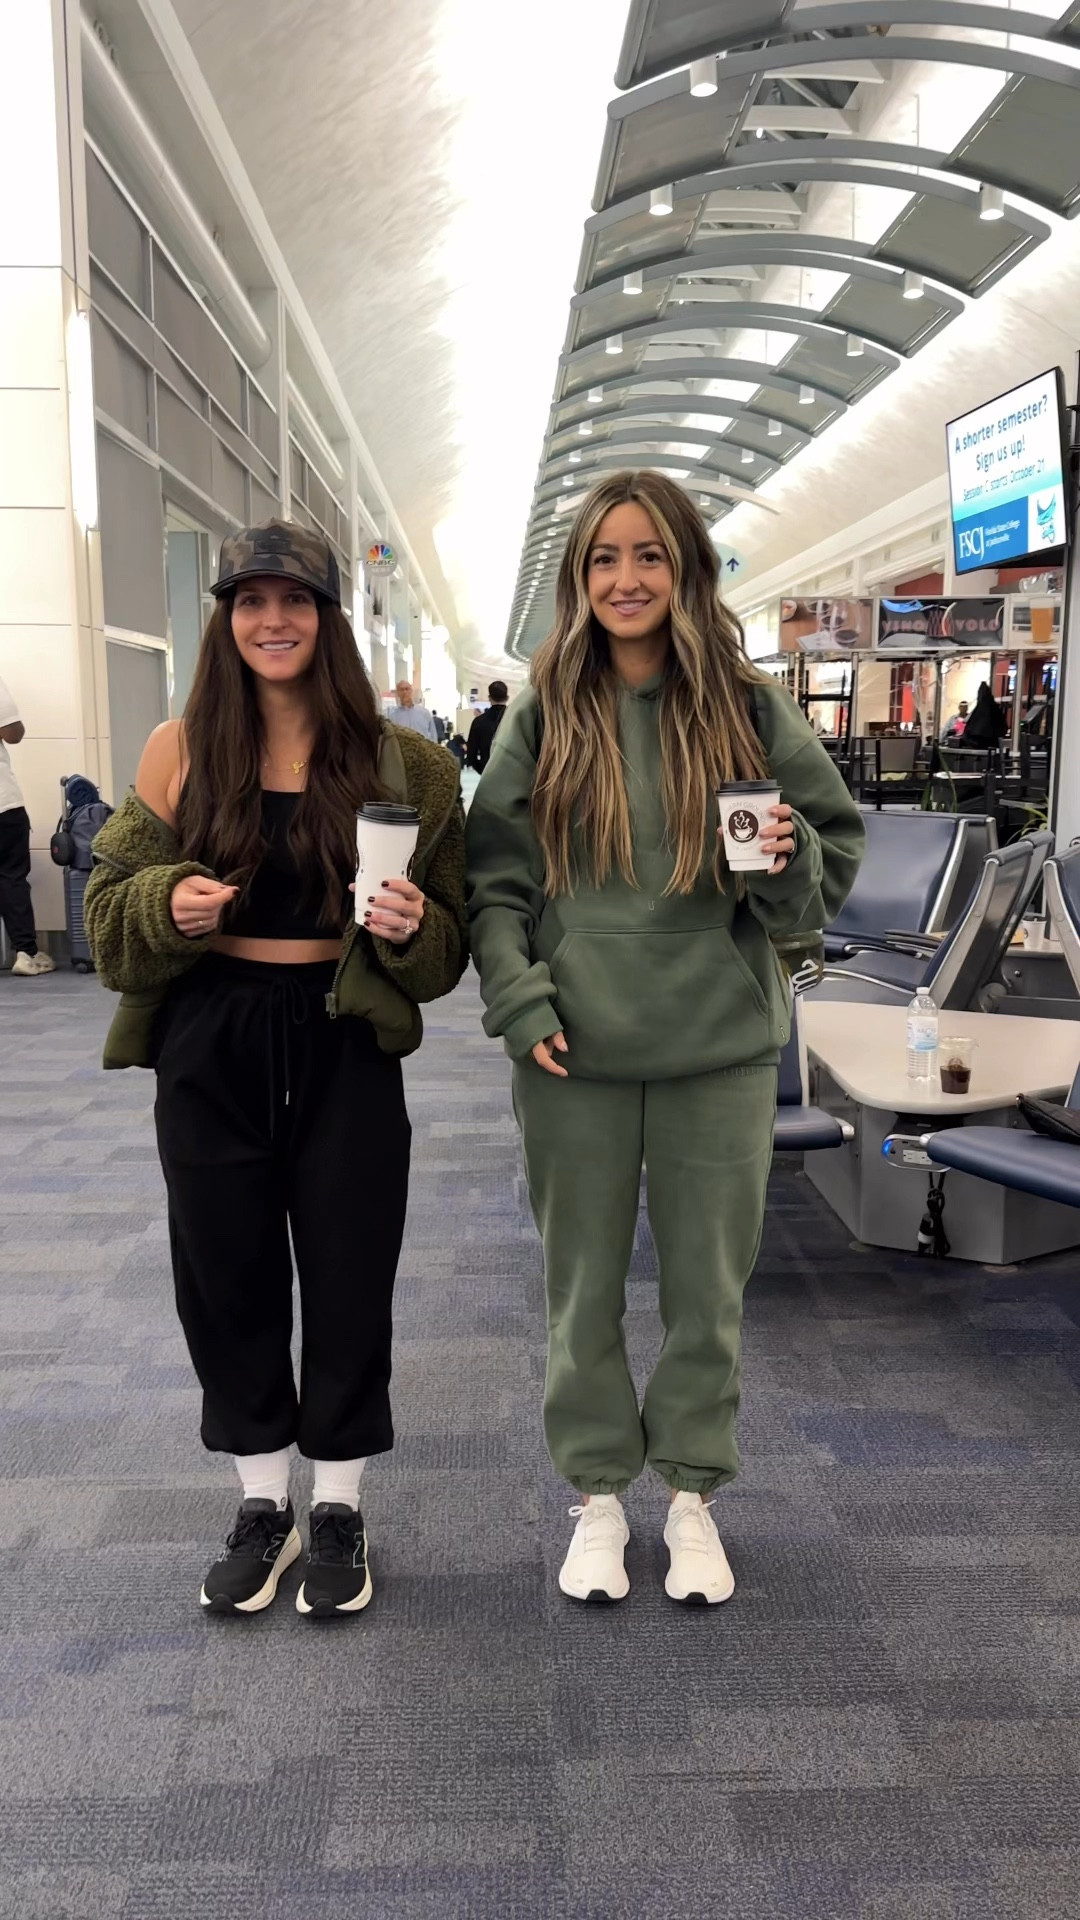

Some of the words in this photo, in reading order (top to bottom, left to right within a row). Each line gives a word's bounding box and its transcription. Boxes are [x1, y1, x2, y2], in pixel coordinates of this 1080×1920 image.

[955, 437, 961, 454] A
[962, 423, 995, 450] shorter
[997, 394, 1048, 434] semester?
[976, 451, 995, 472] Sign
[997, 444, 1008, 463] us
[1010, 434, 1026, 458] up!
[1010, 464, 1036, 483] October
[958, 526, 985, 561] FSCJ
[882, 619, 925, 633] VINO
[955, 618, 999, 632] VOLO
